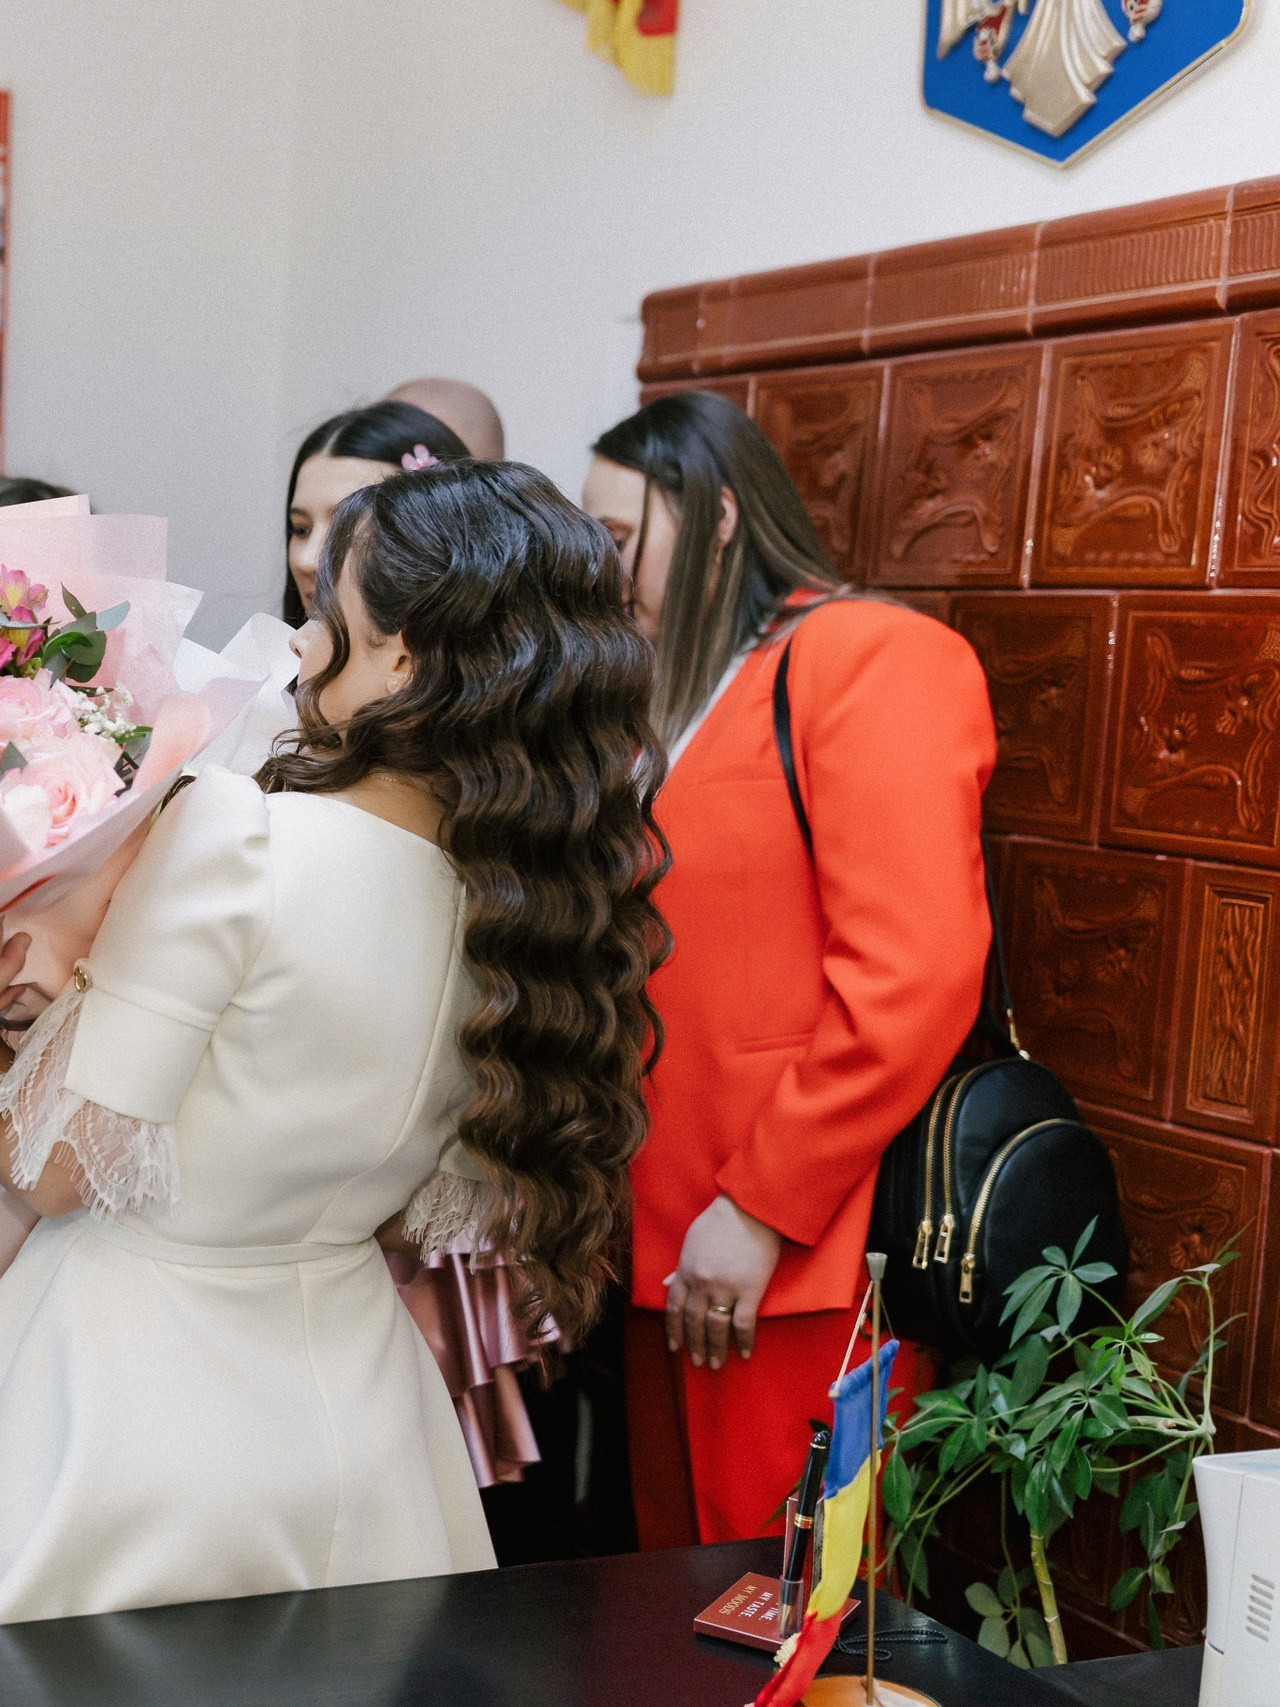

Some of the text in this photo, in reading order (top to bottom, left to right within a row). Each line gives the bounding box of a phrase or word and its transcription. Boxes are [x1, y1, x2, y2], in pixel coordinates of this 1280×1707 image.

[718, 1585, 758, 1615] MY MOODS
[738, 1592, 774, 1617] MY TASTE.
